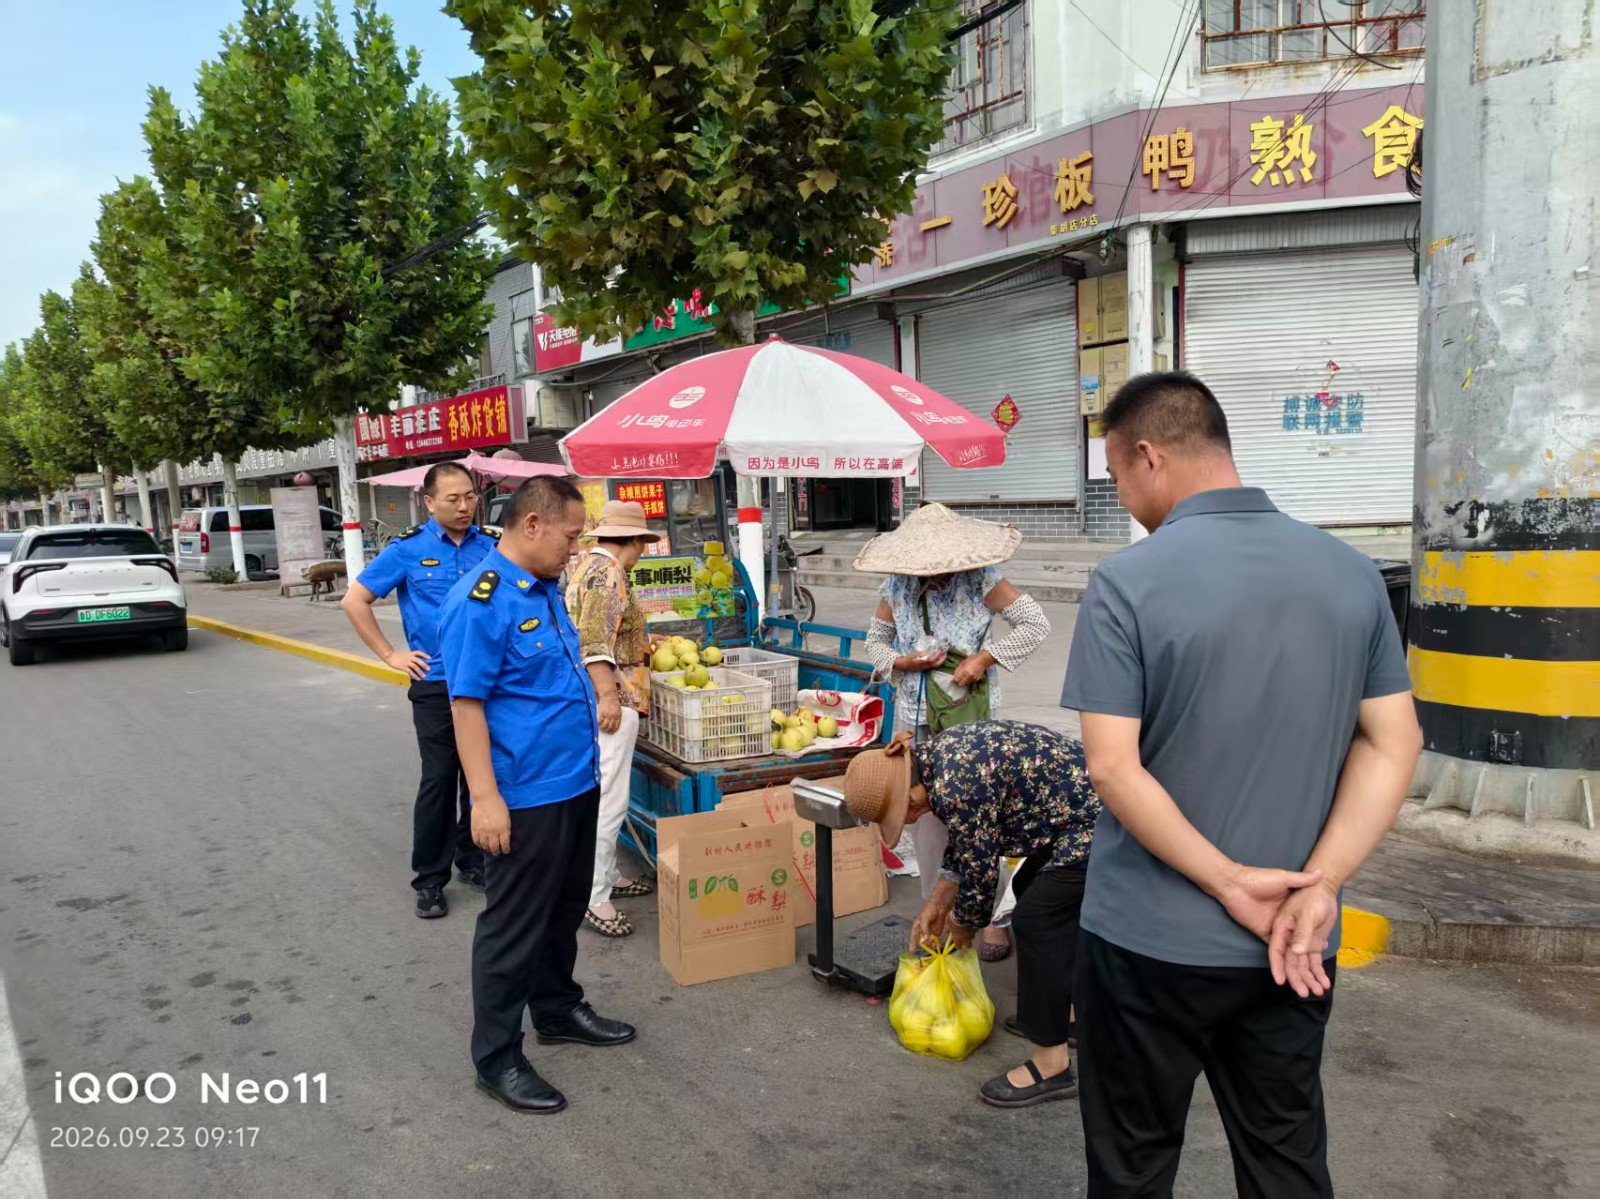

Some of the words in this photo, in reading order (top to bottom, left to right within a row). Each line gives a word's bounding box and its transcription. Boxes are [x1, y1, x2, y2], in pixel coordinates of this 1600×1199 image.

[747, 456, 820, 470] 因为是小鸟
[834, 456, 905, 471] 所以在高端
[619, 485, 664, 500] 杂粮煎饼果子
[746, 886, 786, 912] 酥梨
